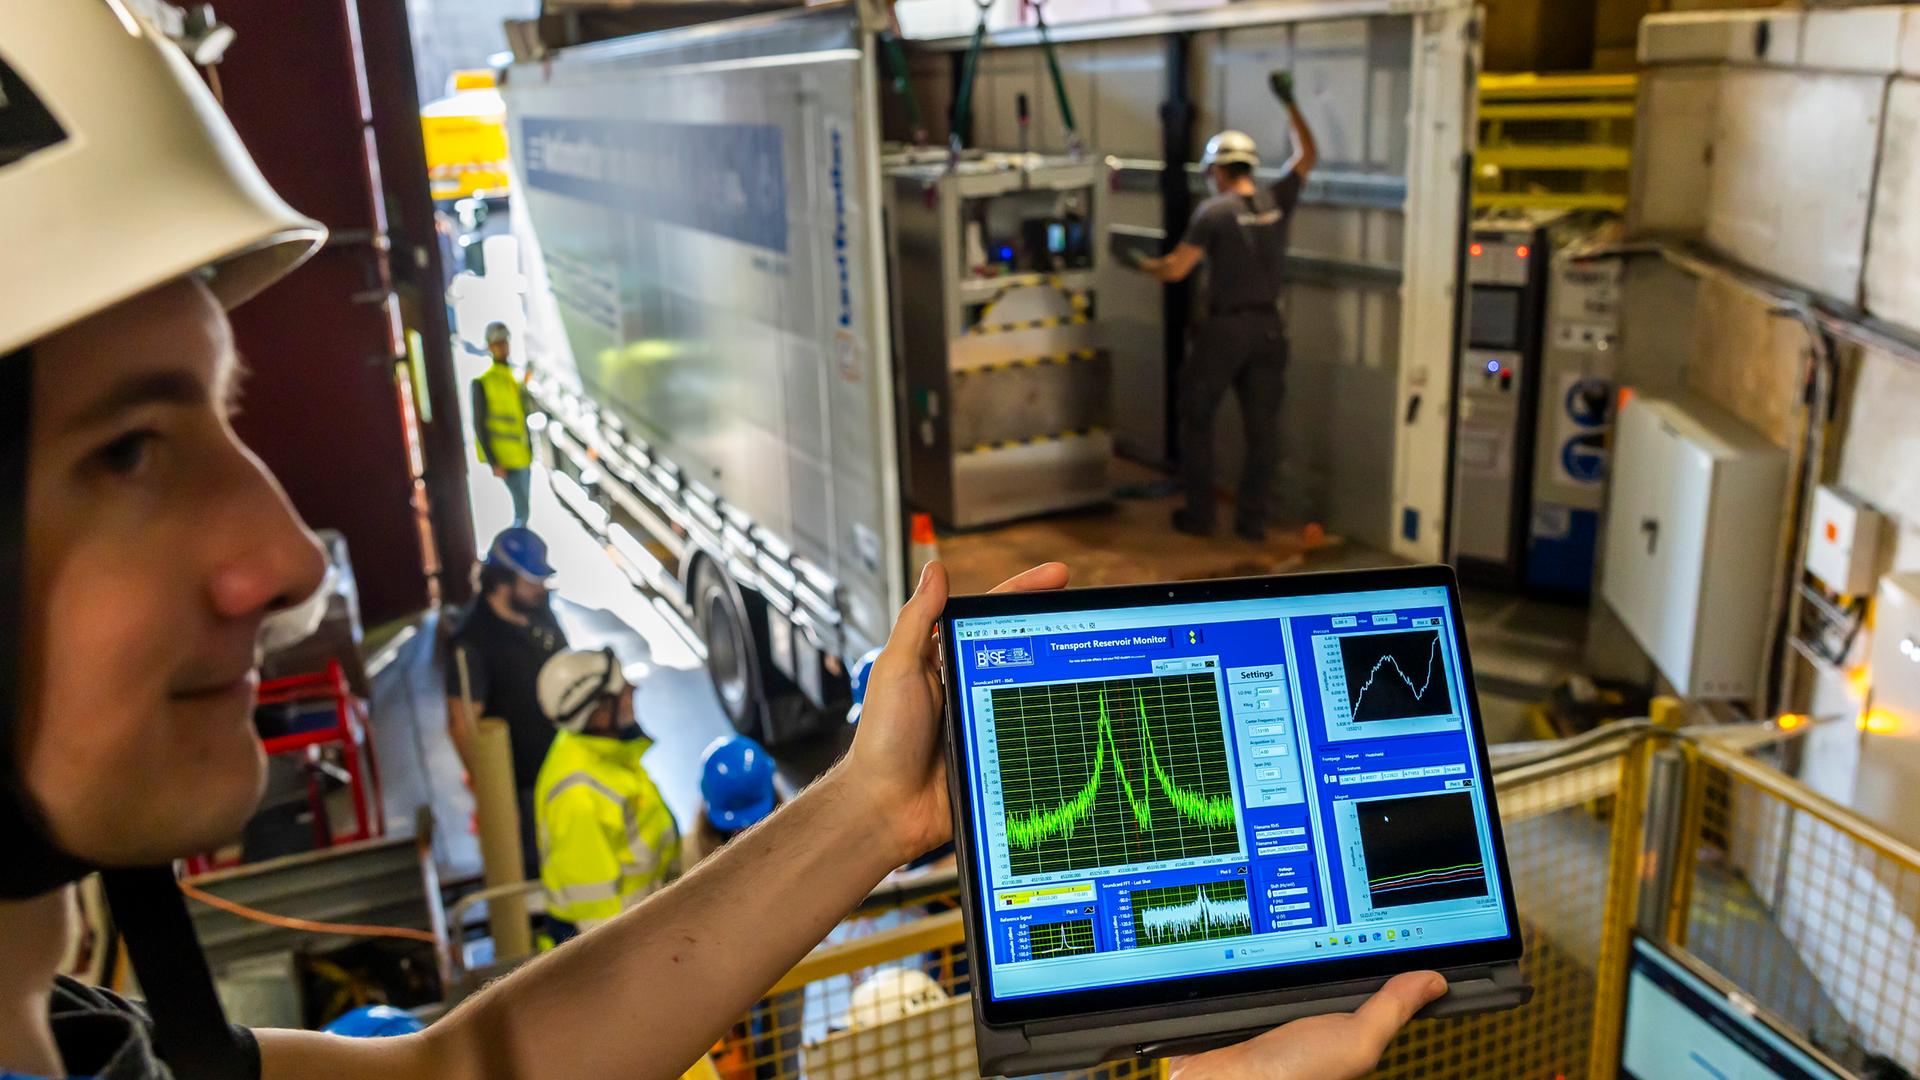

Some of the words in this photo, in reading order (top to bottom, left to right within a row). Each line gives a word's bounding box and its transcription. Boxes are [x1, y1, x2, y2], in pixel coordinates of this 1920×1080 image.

[1050, 640, 1090, 652] Transport
[1093, 637, 1131, 648] Reservoir
[1133, 635, 1167, 645] Monitor
[1241, 669, 1274, 681] Settings
